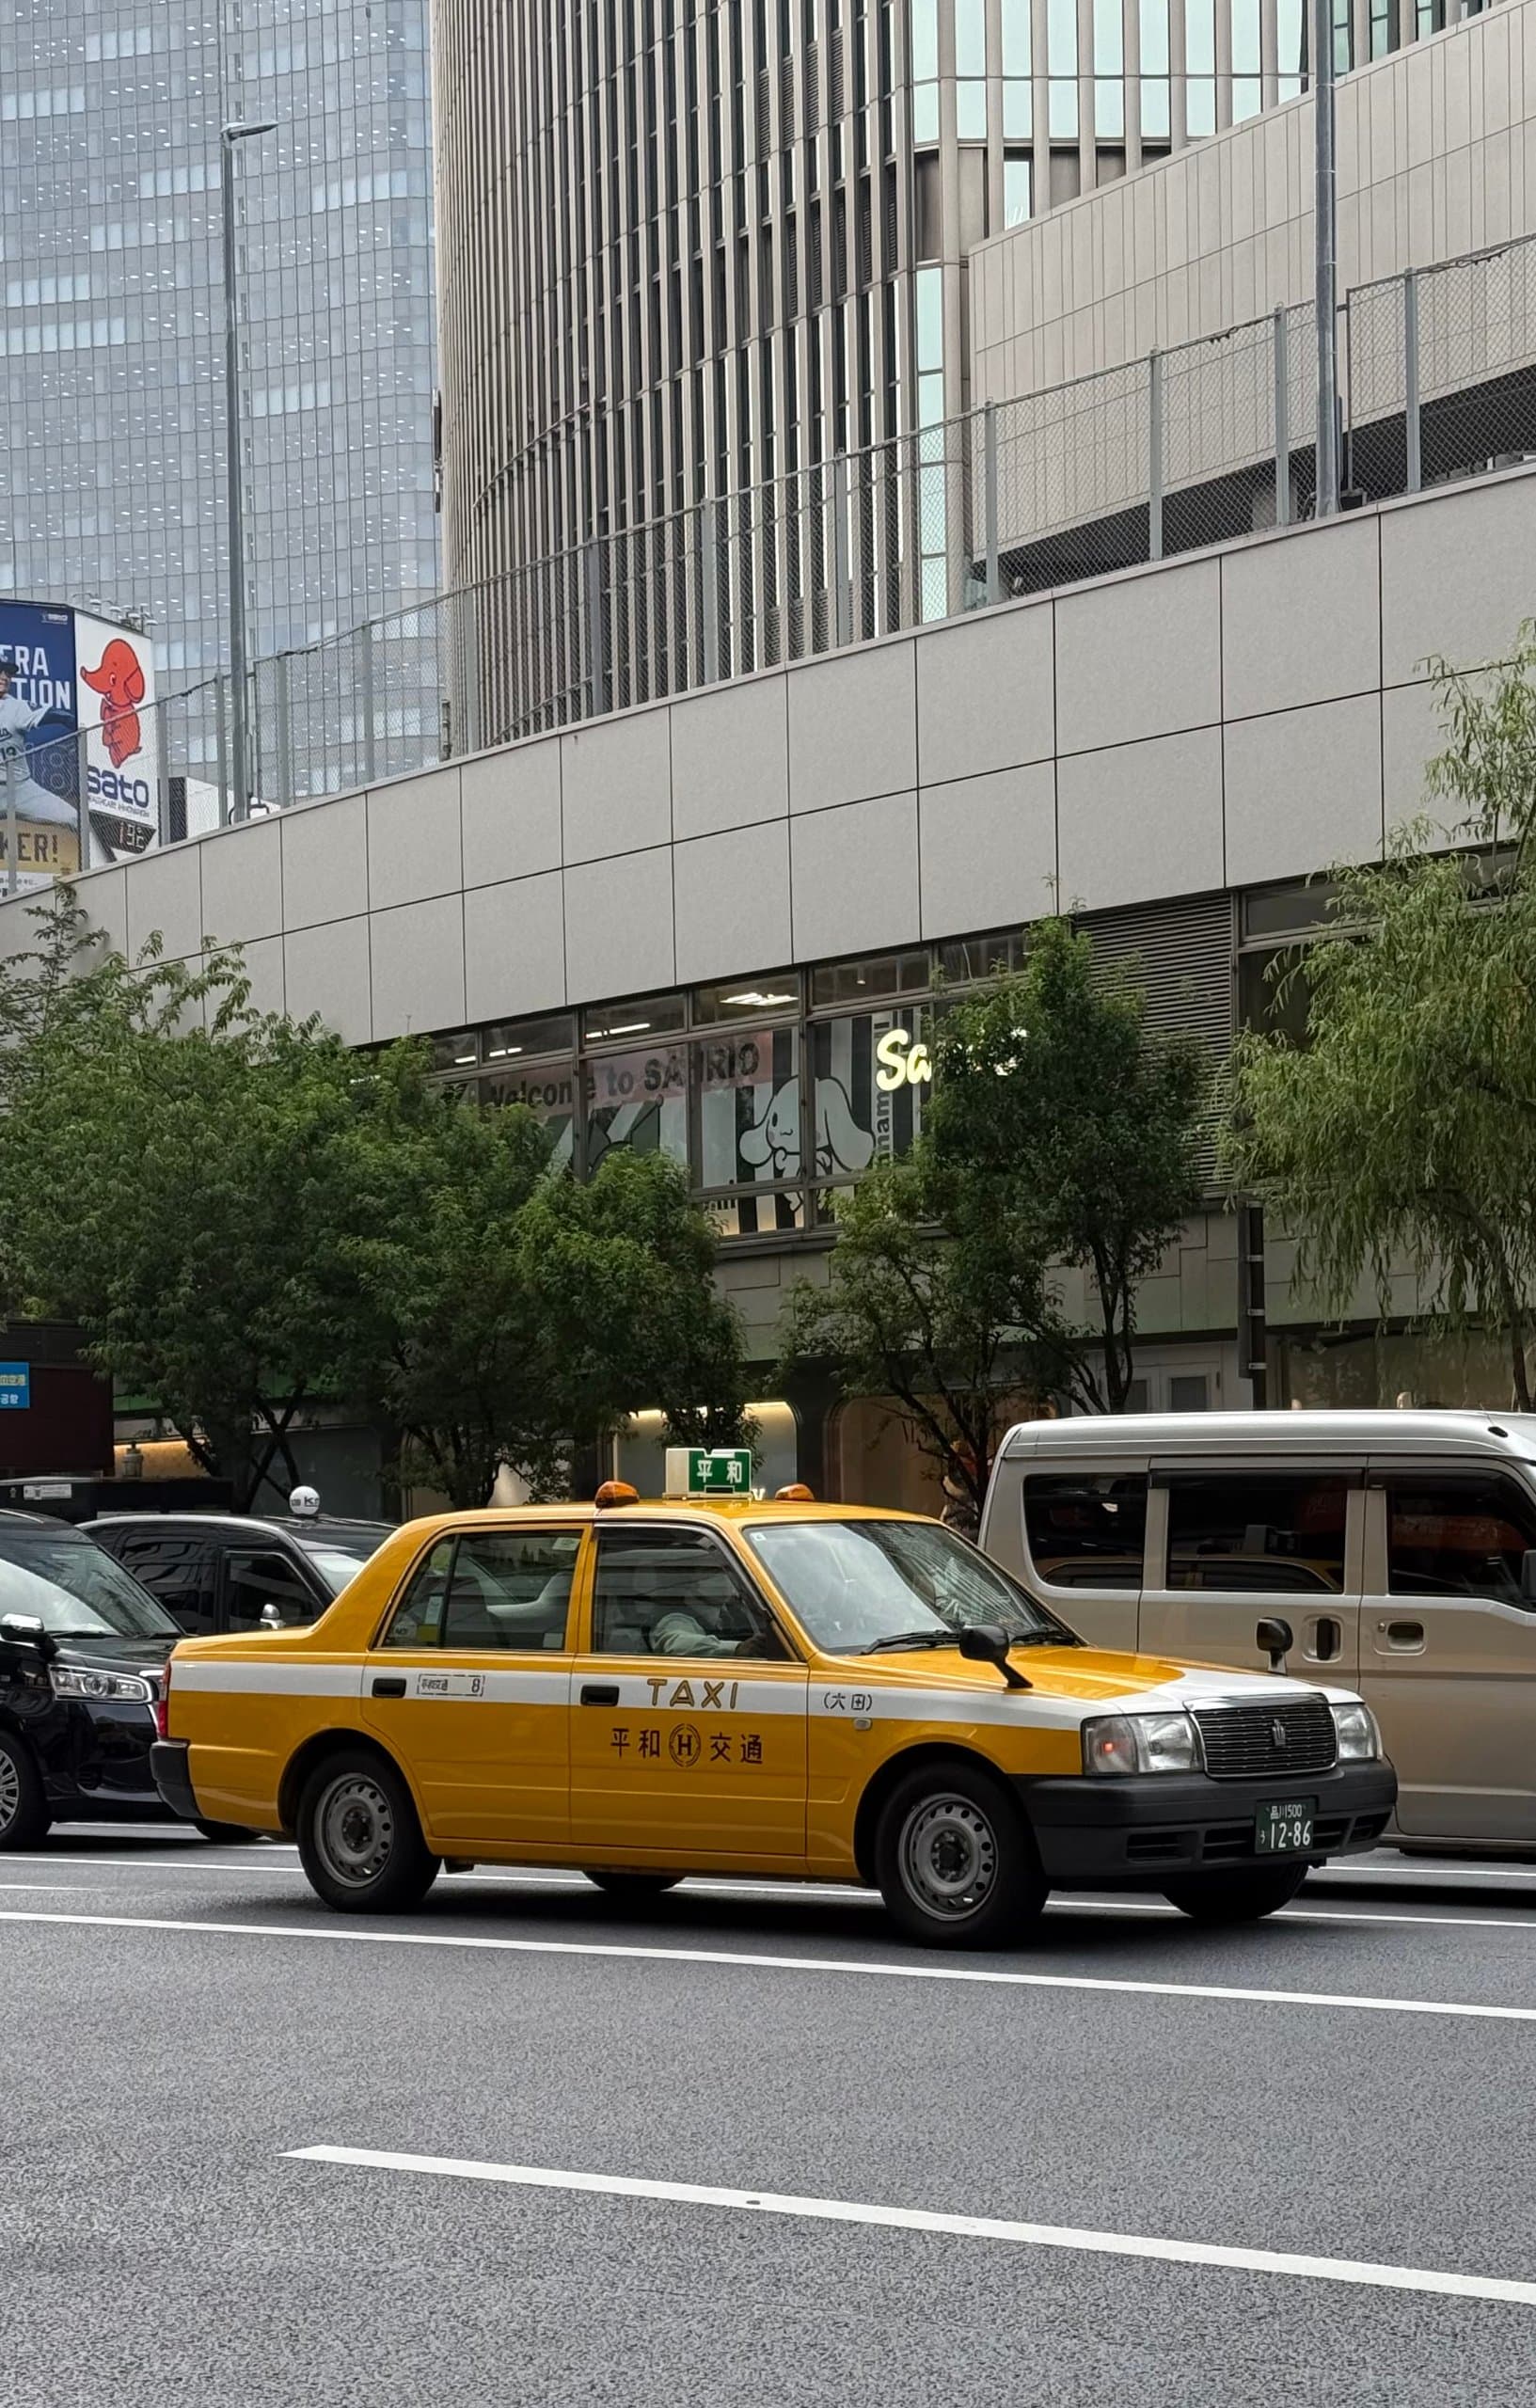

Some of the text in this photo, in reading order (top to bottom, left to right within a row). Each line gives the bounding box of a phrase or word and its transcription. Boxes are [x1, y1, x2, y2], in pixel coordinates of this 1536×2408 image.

[87, 765, 149, 809] sato
[607, 1065, 634, 1096] to
[644, 1041, 760, 1092] SARIO
[696, 1460, 742, 1484] 平和
[471, 1678, 481, 1693] 8
[647, 1678, 738, 1709] TAXI
[610, 1727, 660, 1759] 平和
[709, 1732, 763, 1765] 交通
